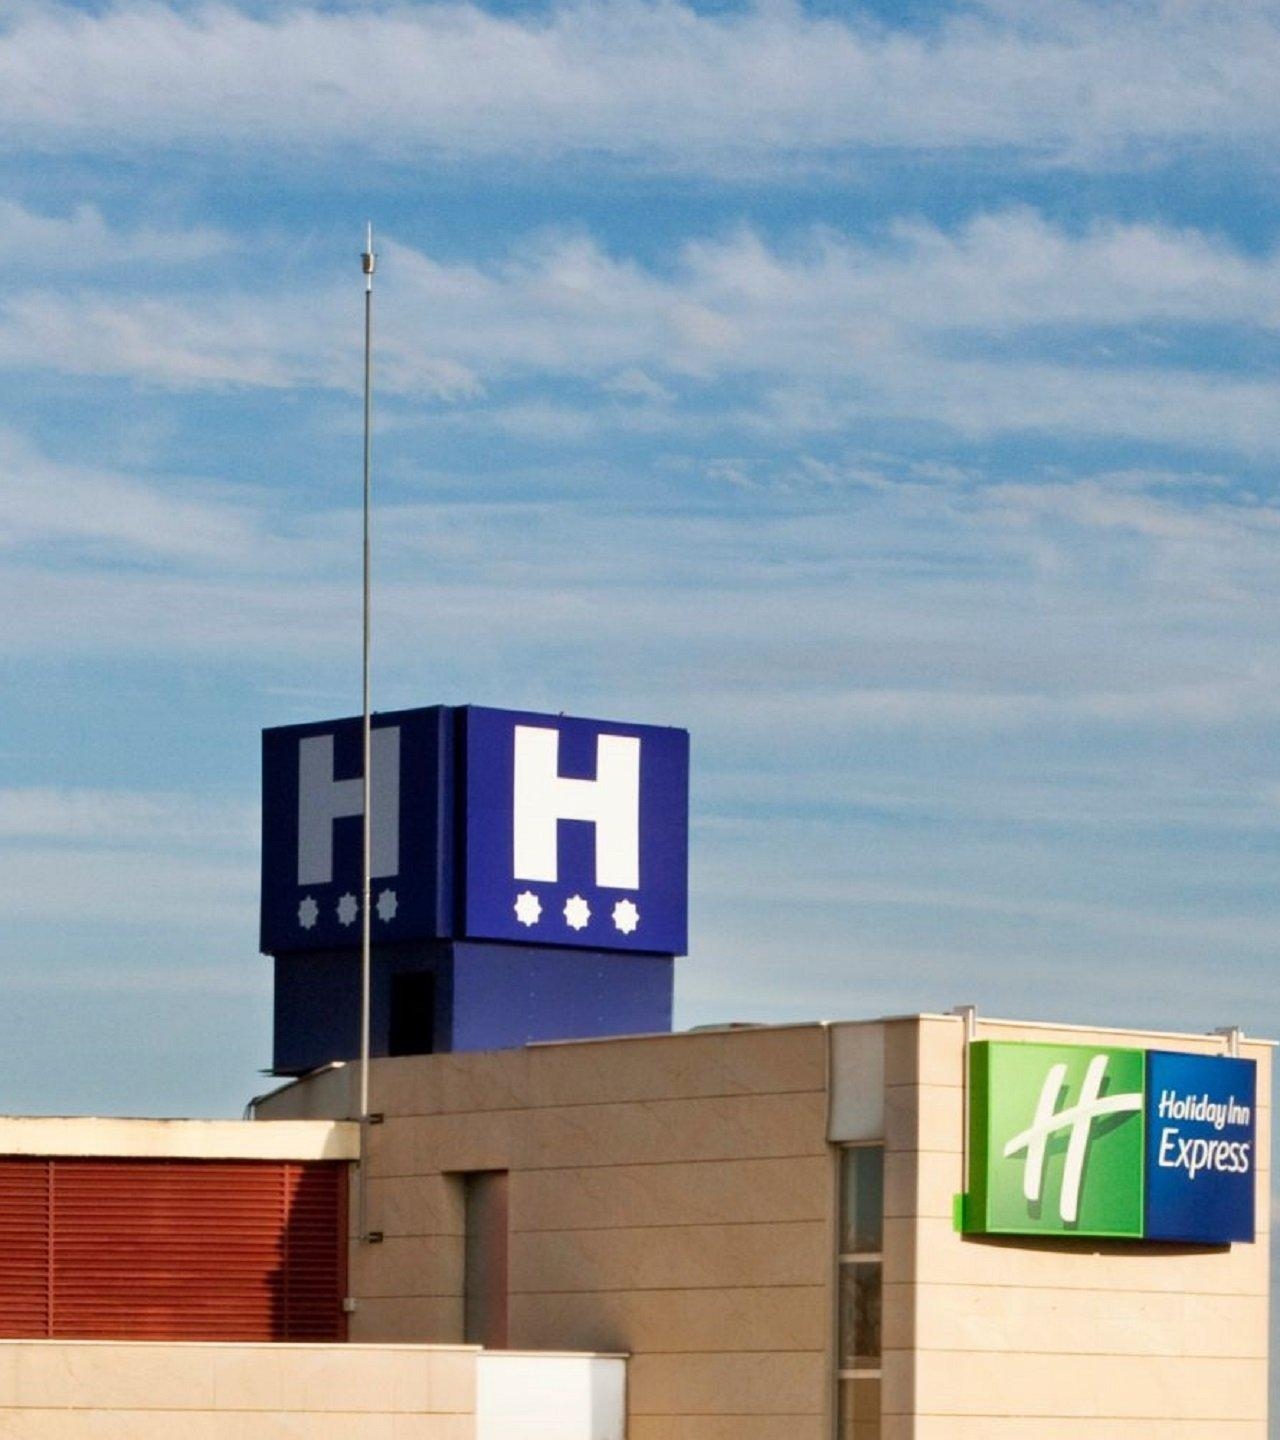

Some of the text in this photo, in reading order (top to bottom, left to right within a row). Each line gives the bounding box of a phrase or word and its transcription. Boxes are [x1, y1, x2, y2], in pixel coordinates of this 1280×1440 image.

[298, 726, 400, 885] H
[514, 725, 640, 890] H
[1159, 1090, 1250, 1130] Holiday Inn
[1159, 1127, 1250, 1179] Express
